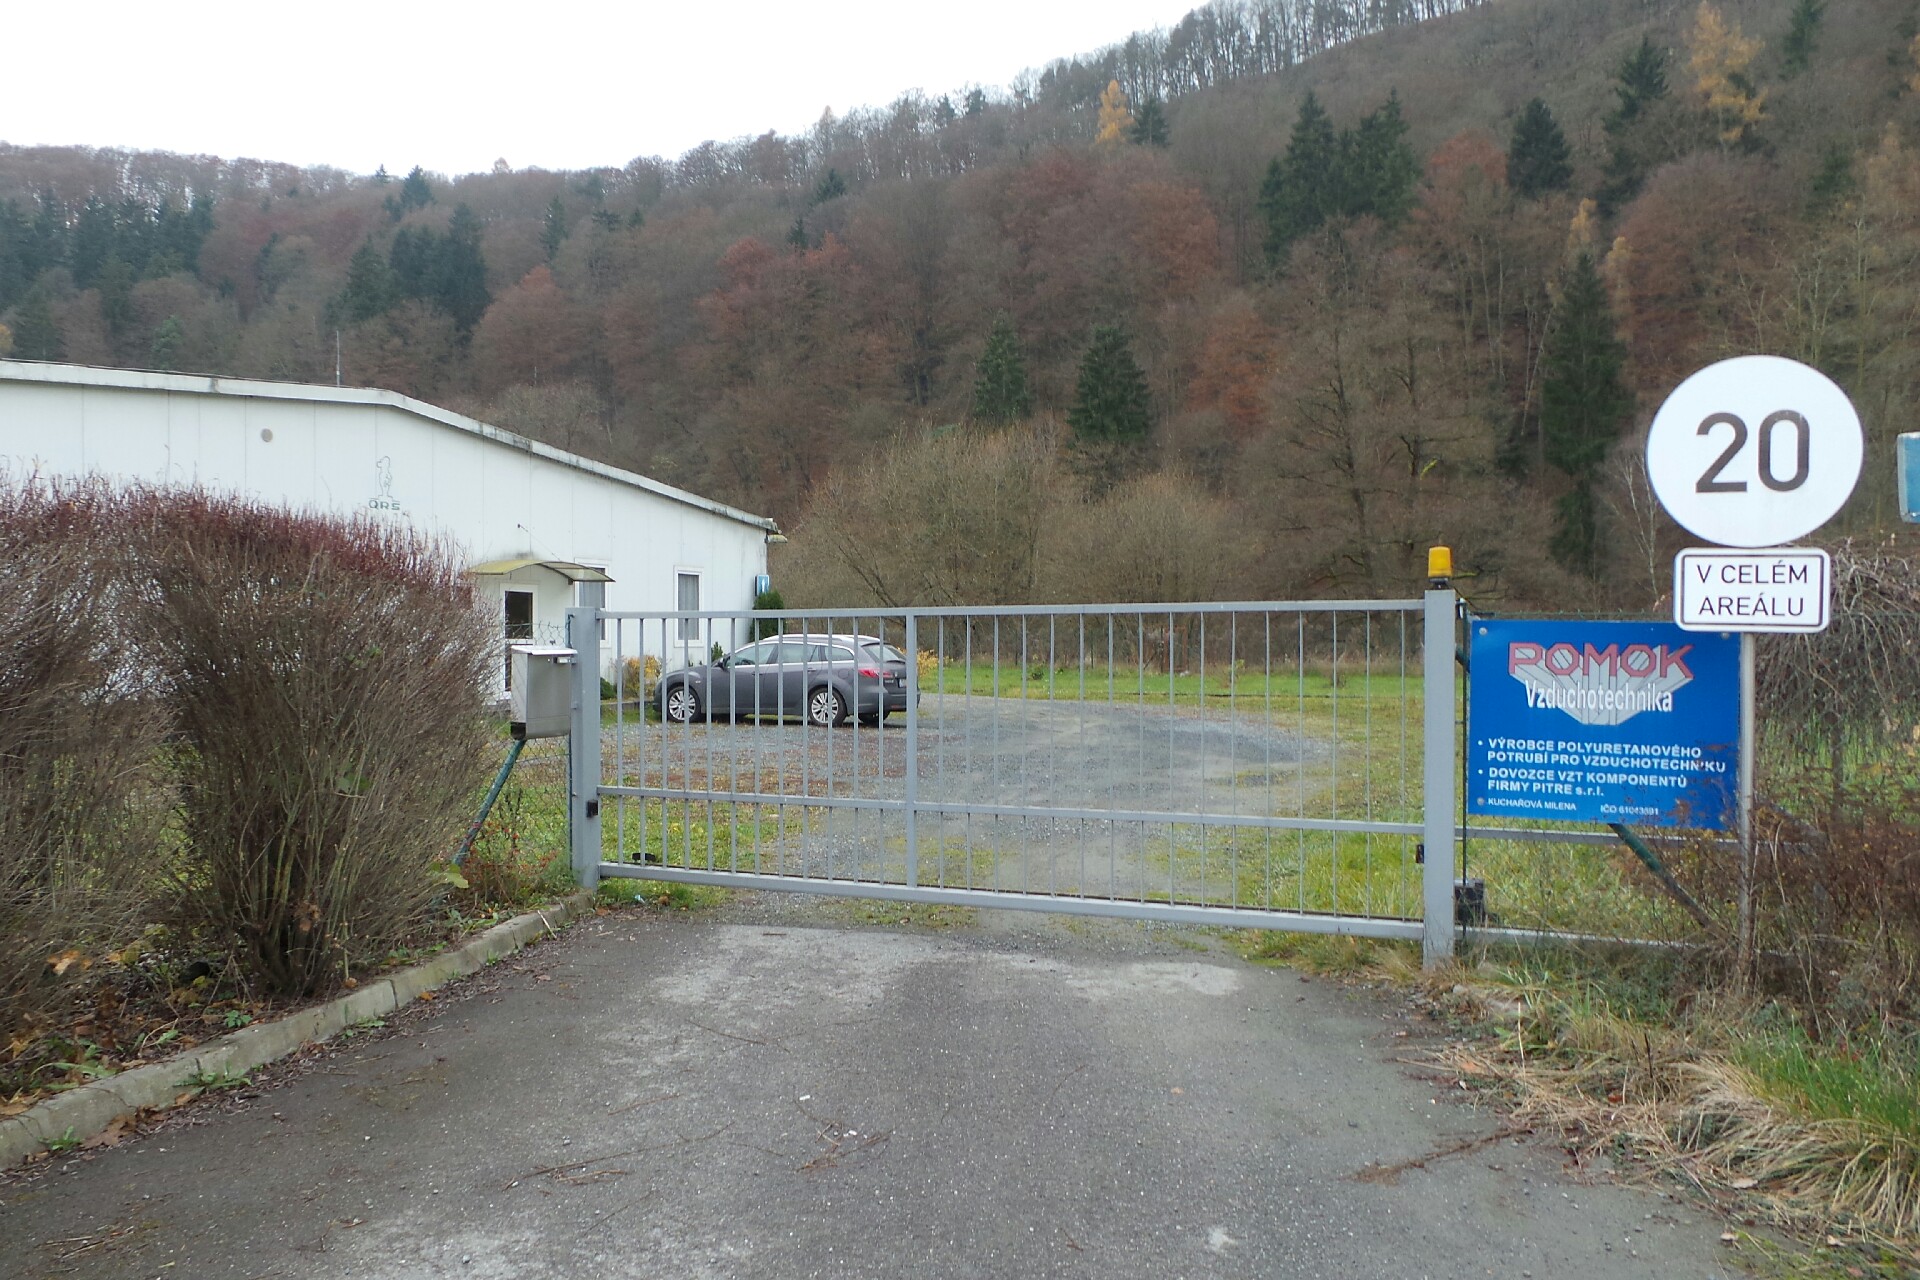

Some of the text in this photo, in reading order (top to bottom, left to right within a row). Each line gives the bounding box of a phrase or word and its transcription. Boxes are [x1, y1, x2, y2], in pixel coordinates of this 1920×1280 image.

[1695, 409, 1810, 492] 20
[368, 499, 401, 511] QRS
[1697, 559, 1808, 584] V CELÉM
[1698, 592, 1804, 617] AREÁLU
[1508, 641, 1694, 680] POMOK
[1525, 679, 1673, 713] Vzduchotechnika
[1487, 750, 1549, 764] POTRUBÍ
[1551, 754, 1580, 766] PRO
[1488, 737, 1702, 758] VÝROBCE POLYURETANOVÉHO
[1488, 779, 1530, 792] FIRMY
[1532, 783, 1573, 795] PITRE
[1489, 767, 1687, 788] DOVOZCE VZT KOMPONENTŮ
[1488, 797, 1543, 809] KUCHAŘOVÁ
[1544, 802, 1577, 811] MILENA
